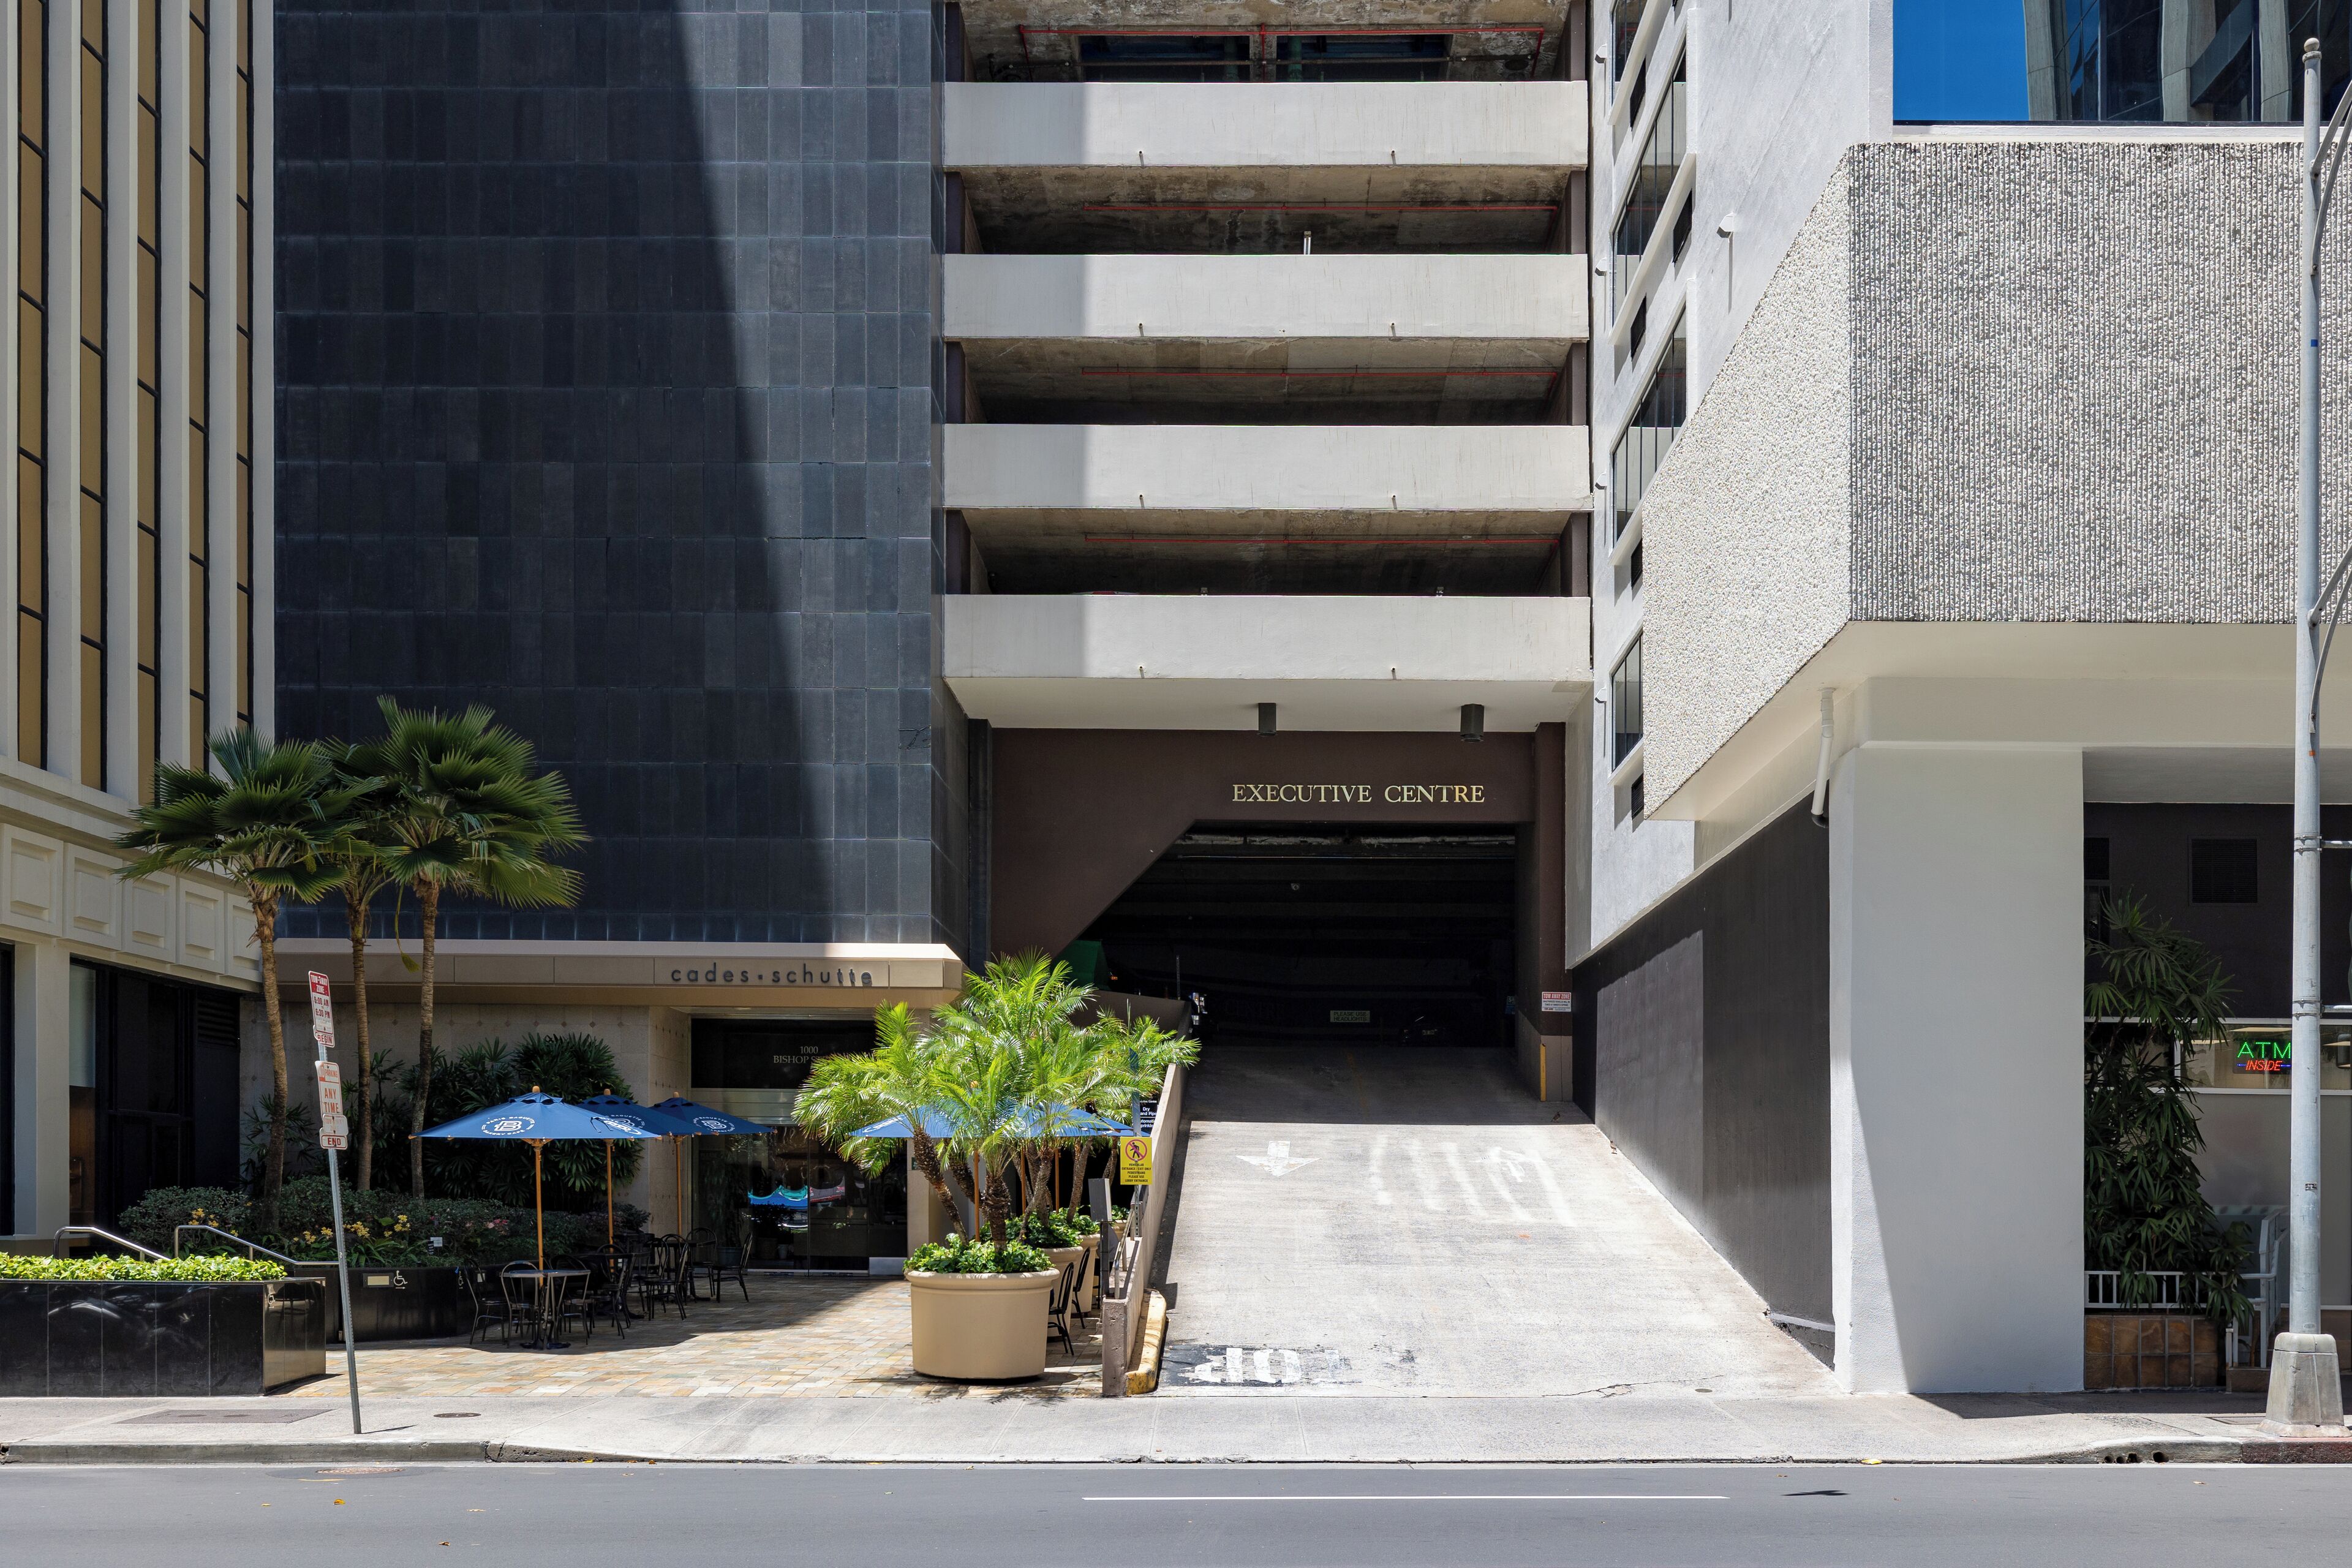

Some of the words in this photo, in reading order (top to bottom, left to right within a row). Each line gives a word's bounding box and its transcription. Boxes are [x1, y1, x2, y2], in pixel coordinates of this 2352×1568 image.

[1232, 784, 1372, 803] EXECUTIVE
[1384, 785, 1485, 803] CENTRE
[323, 998, 330, 1007] AM
[315, 1008, 324, 1017] 6:30
[325, 1010, 331, 1019] PM
[317, 1035, 333, 1044] BEGIN
[799, 1046, 818, 1054] 1000
[2237, 1041, 2291, 1059] ATM
[773, 1055, 809, 1064] BISHOP
[2245, 1060, 2283, 1071] INSIDE
[325, 1069, 338, 1078] PARKING
[324, 1087, 336, 1099] ANY
[323, 1102, 341, 1114] TIME
[327, 1137, 341, 1146] END
